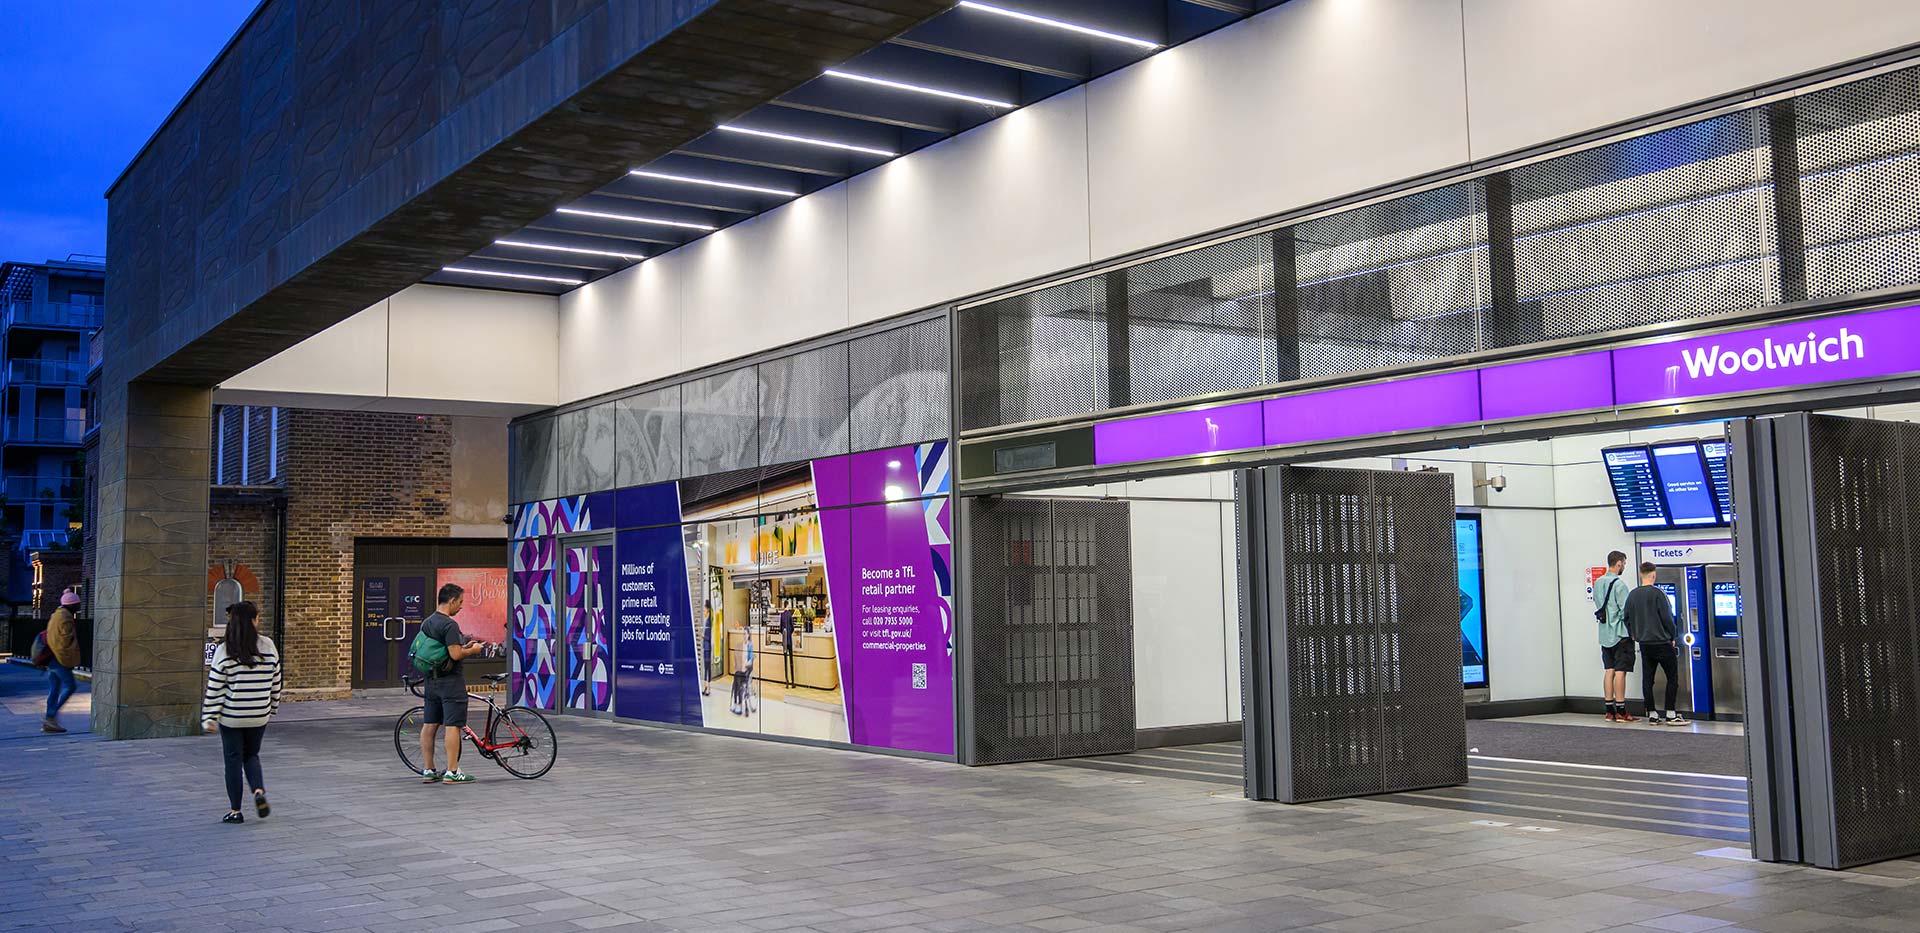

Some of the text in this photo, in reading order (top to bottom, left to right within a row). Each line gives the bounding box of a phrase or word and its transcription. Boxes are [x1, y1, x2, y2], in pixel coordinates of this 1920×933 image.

[1682, 328, 1864, 379] Woolwich
[1653, 549, 1683, 557] Tickets
[622, 562, 654, 575] Millions of
[862, 566, 915, 579] Become a TfL
[622, 581, 655, 592] customers,
[862, 583, 915, 597] retail partner
[622, 596, 657, 610] prime retail
[862, 604, 920, 615] For leasing enquiries,
[622, 613, 670, 627] spaces, creating
[862, 617, 913, 625] call 020 7935 5000
[621, 629, 670, 642] jobs for London
[870, 629, 881, 637] visit
[862, 641, 926, 651] commercial-properties
